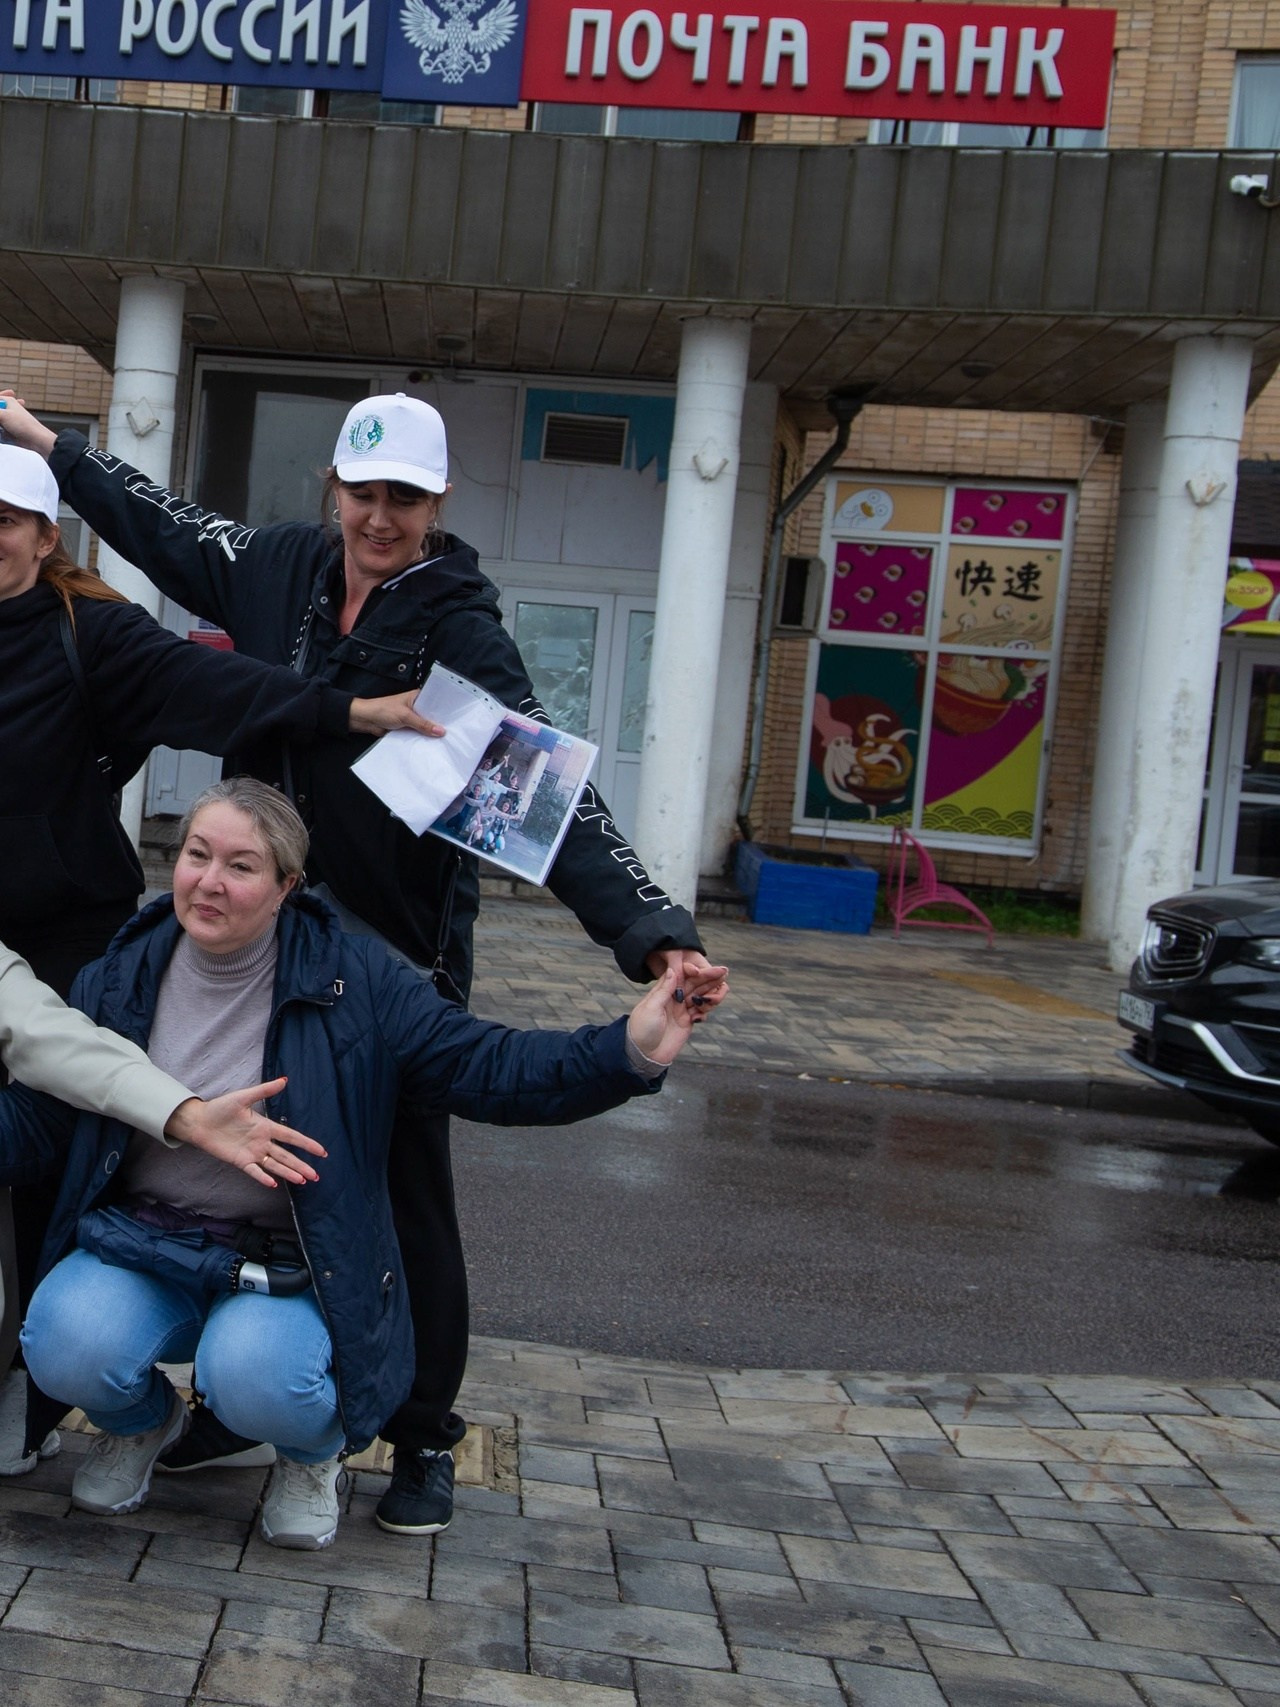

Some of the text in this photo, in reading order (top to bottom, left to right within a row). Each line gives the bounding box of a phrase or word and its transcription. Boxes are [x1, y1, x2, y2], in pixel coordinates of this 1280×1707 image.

[118, 0, 371, 66] РОССИИ
[564, 7, 1065, 99] ПОЧТА БАНК
[955, 559, 1044, 602] 快速
